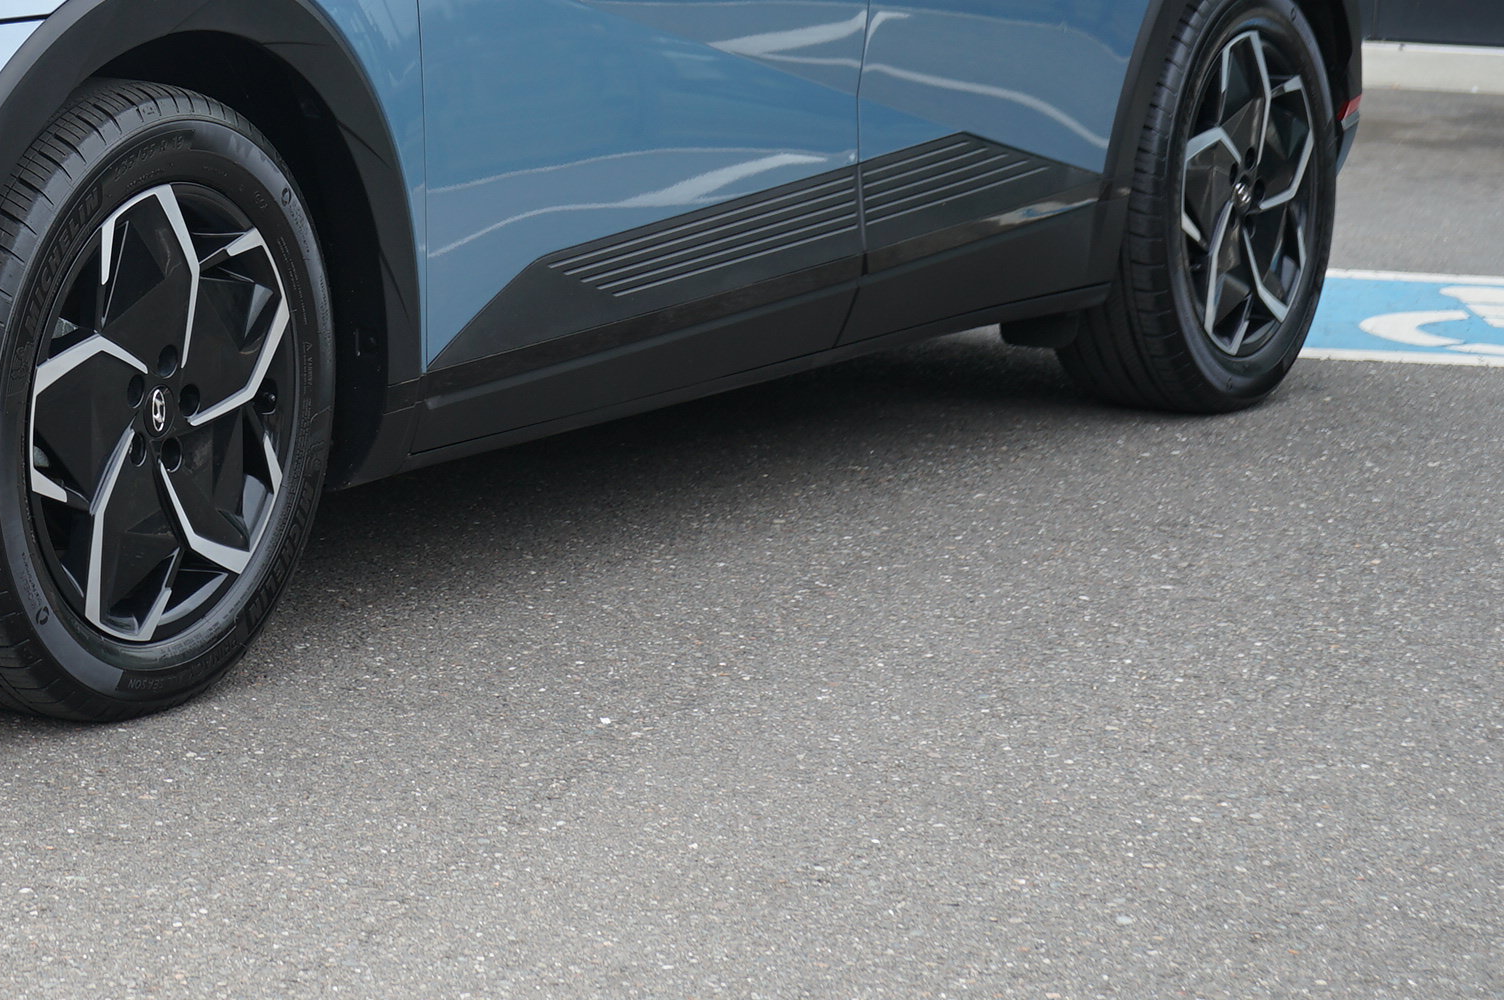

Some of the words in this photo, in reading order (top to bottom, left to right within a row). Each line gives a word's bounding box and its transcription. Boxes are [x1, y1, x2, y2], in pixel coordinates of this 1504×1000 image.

[24, 187, 99, 336] MICHELIN
[246, 474, 315, 627] MICHELIN
[128, 678, 164, 690] SEASON
